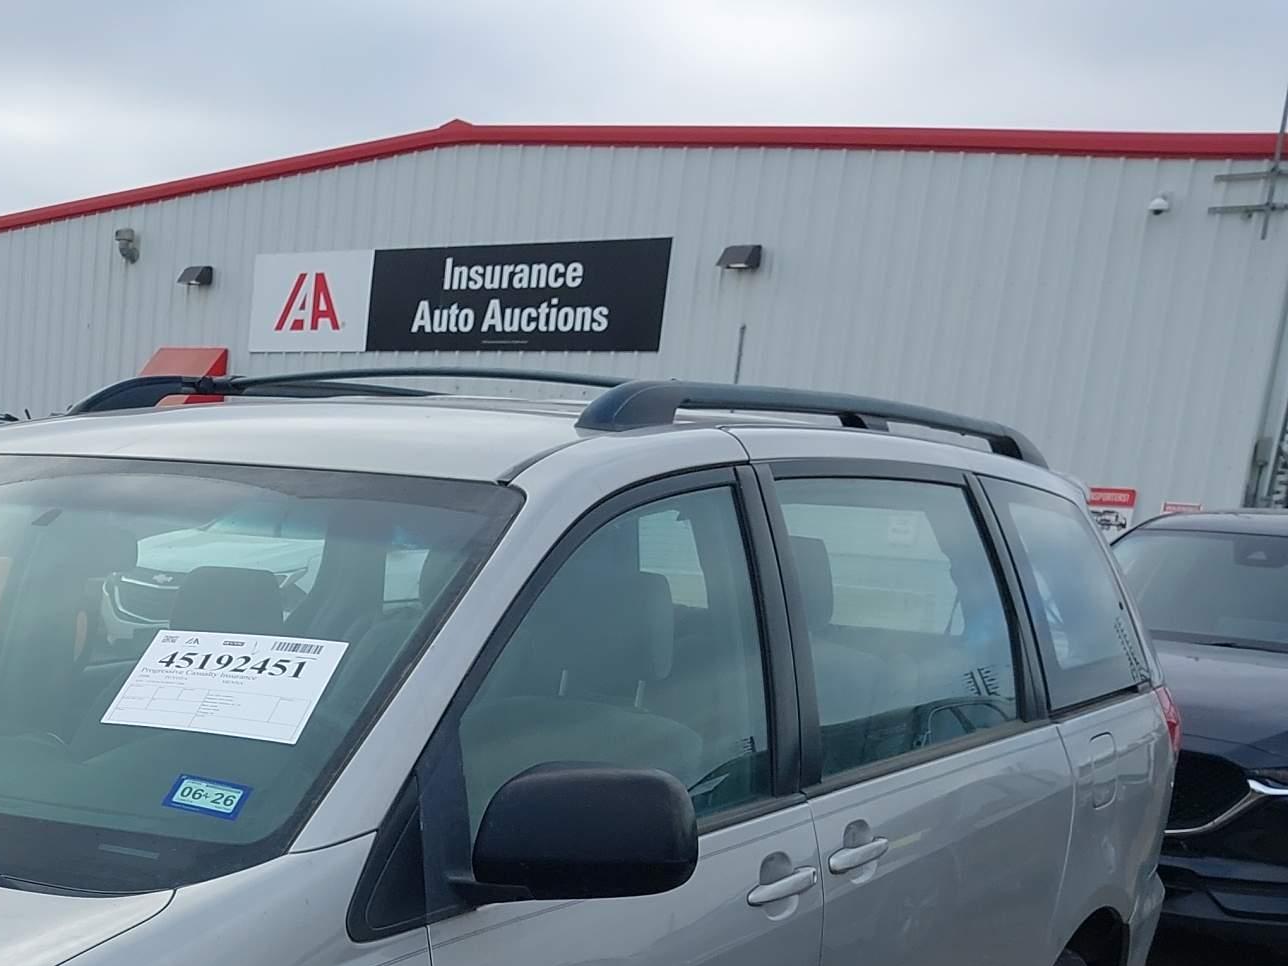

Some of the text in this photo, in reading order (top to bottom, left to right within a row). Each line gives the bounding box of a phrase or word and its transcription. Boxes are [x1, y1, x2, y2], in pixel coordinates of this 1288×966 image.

[443, 257, 584, 290] Insurance
[411, 297, 609, 333] Auto Auctions
[140, 667, 184, 677] Progressive
[219, 672, 258, 681] Insurance
[157, 650, 307, 679] 45192451
[179, 786, 206, 801] 06
[210, 792, 237, 807] 26
